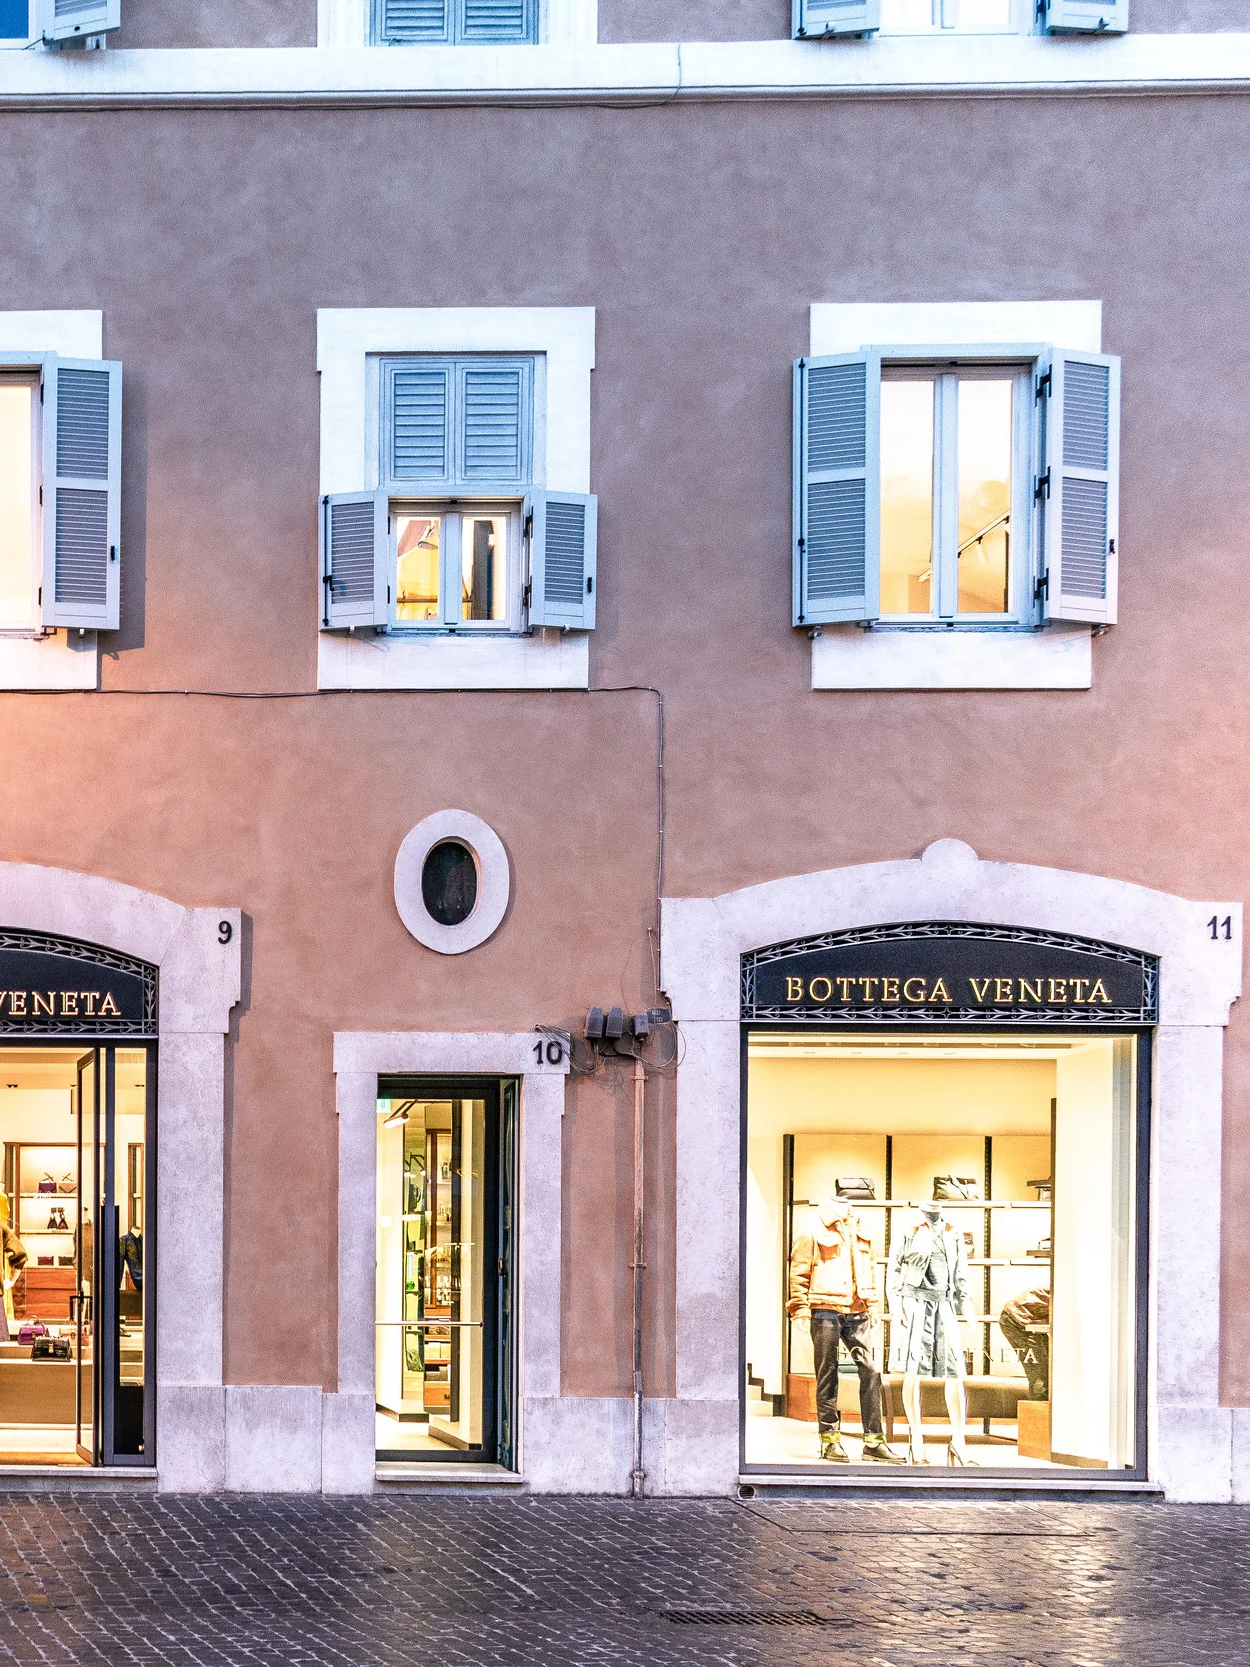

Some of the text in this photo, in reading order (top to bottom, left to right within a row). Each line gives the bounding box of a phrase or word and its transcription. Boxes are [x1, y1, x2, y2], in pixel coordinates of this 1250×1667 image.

[217, 920, 233, 945] 9
[1207, 915, 1232, 940] 11
[786, 976, 1113, 1003] BOTTEGA VENETA
[532, 1040, 563, 1065] 10
